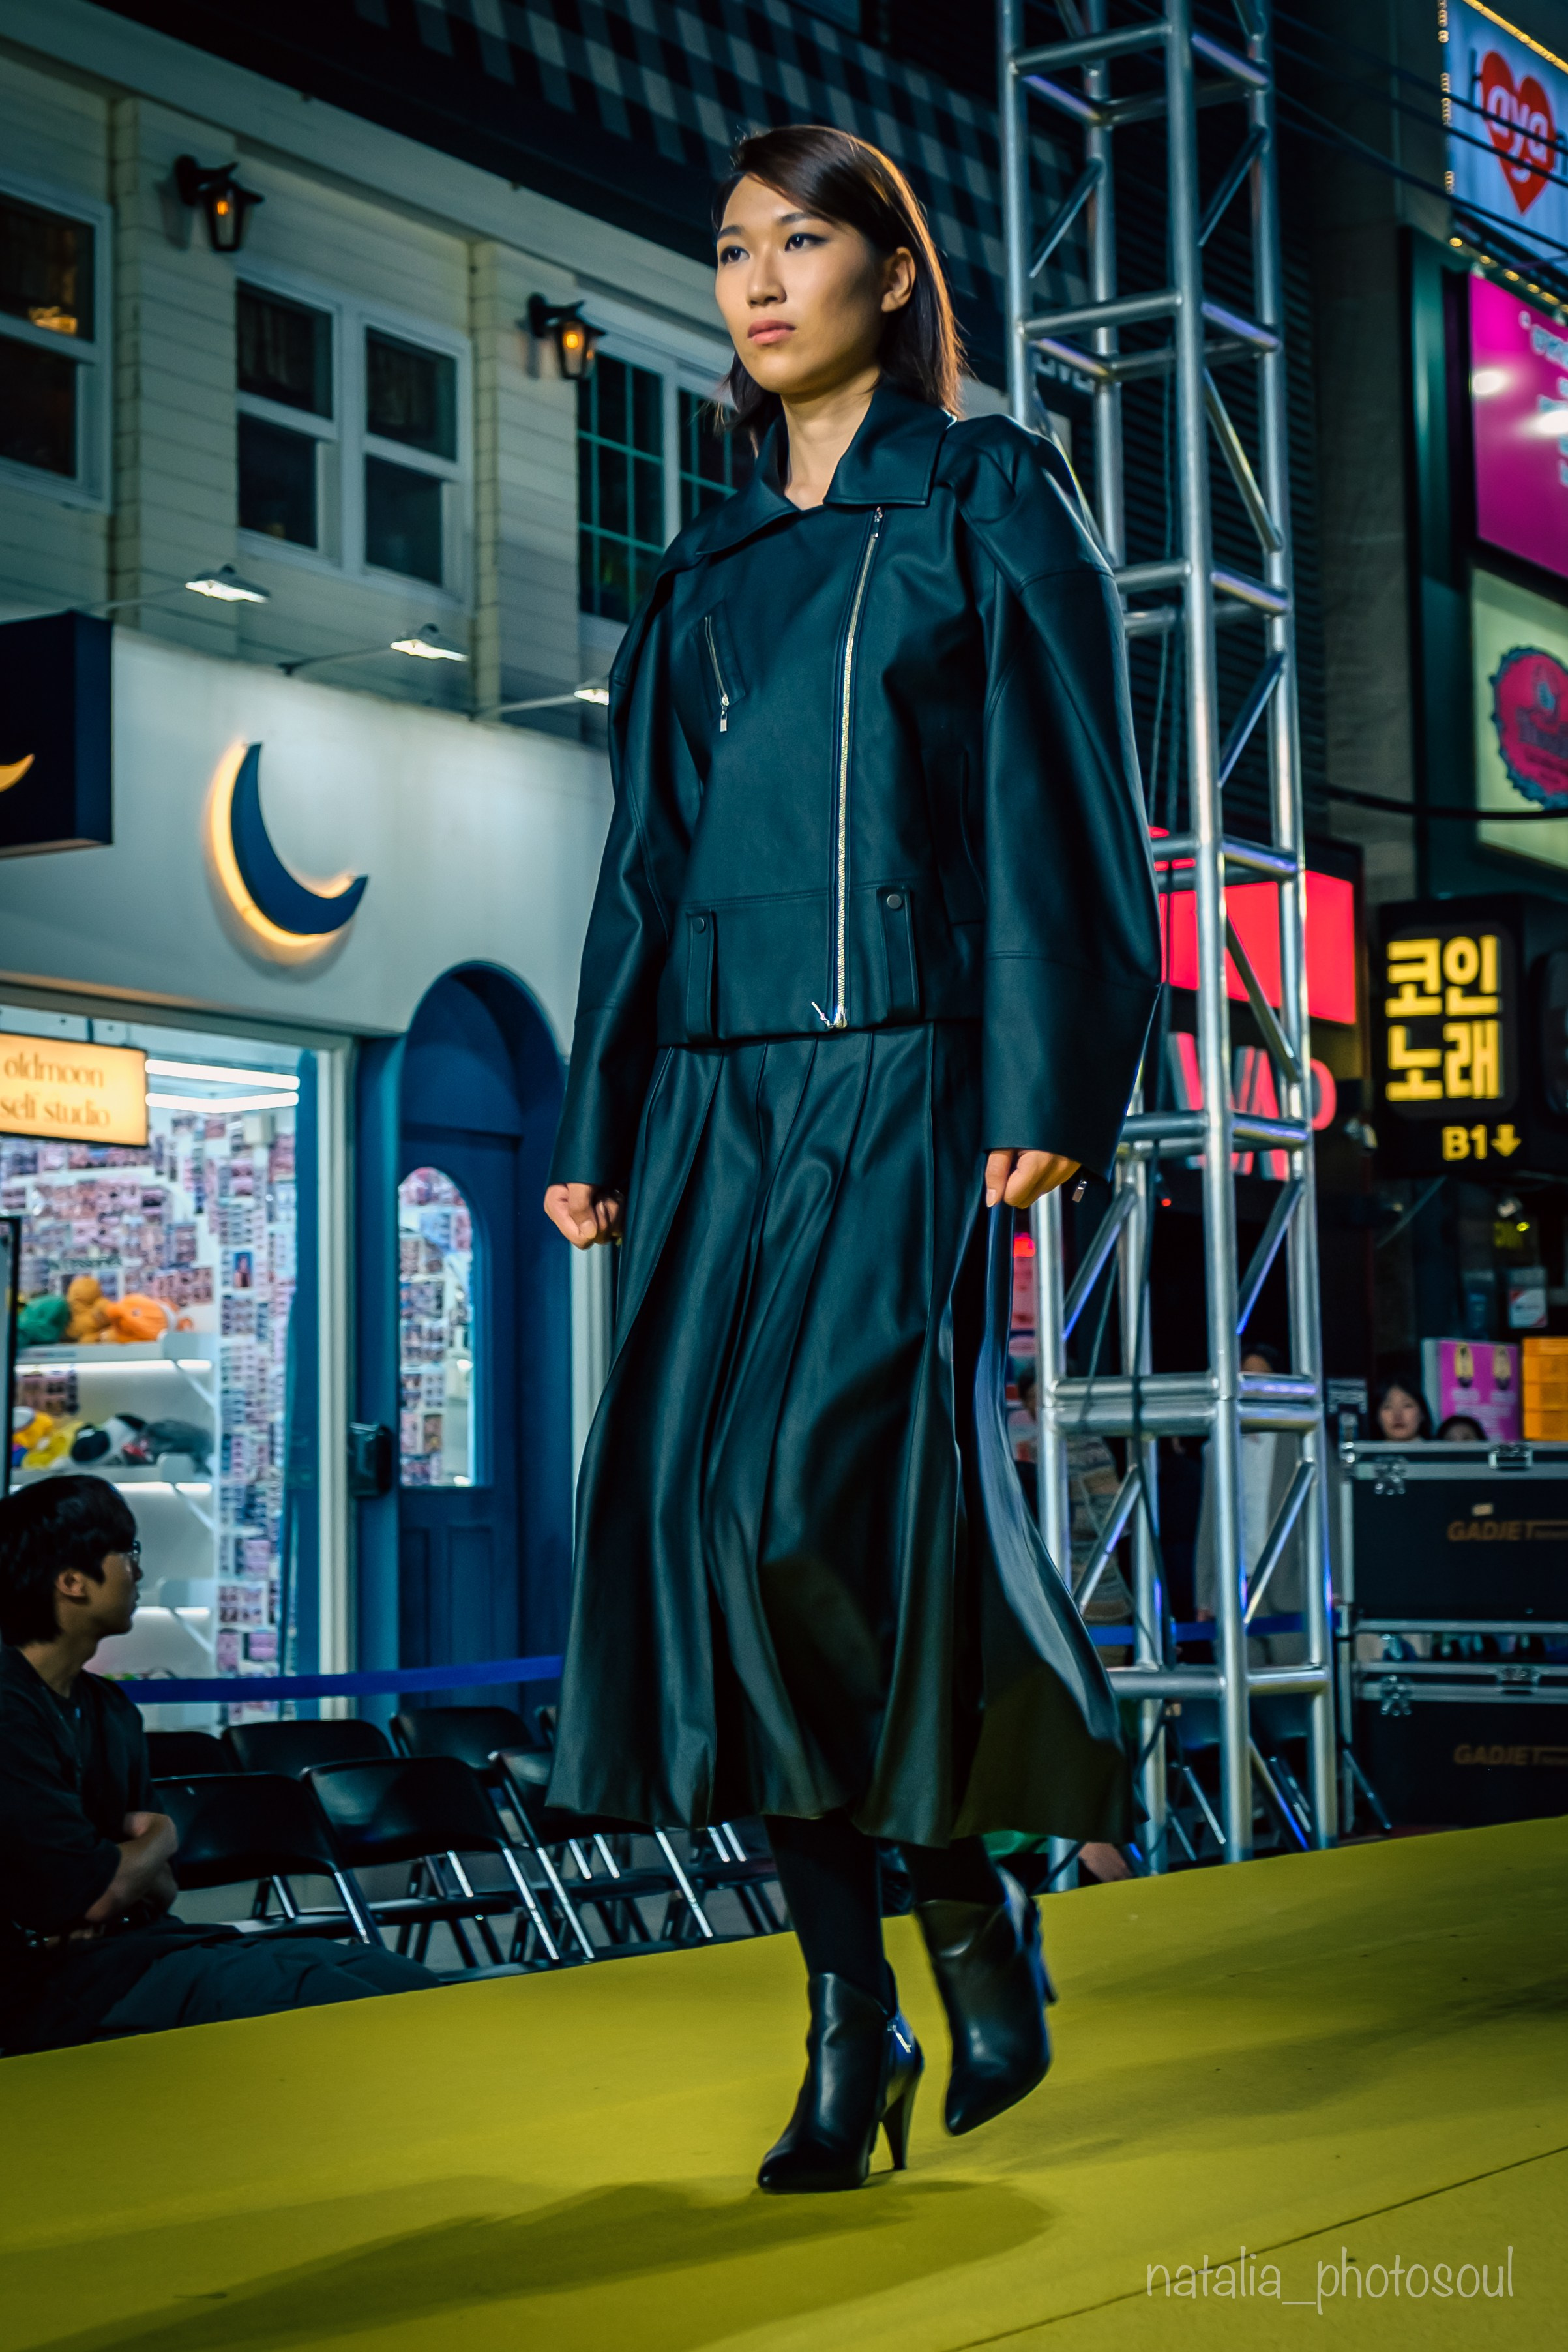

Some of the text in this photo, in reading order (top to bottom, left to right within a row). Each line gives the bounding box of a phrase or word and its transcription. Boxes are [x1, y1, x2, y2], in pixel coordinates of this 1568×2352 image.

[1385, 935, 1500, 1017] 코인
[4, 1051, 104, 1088] oldmoon
[1385, 1020, 1500, 1101] 노래
[1442, 1124, 1488, 1161] B1
